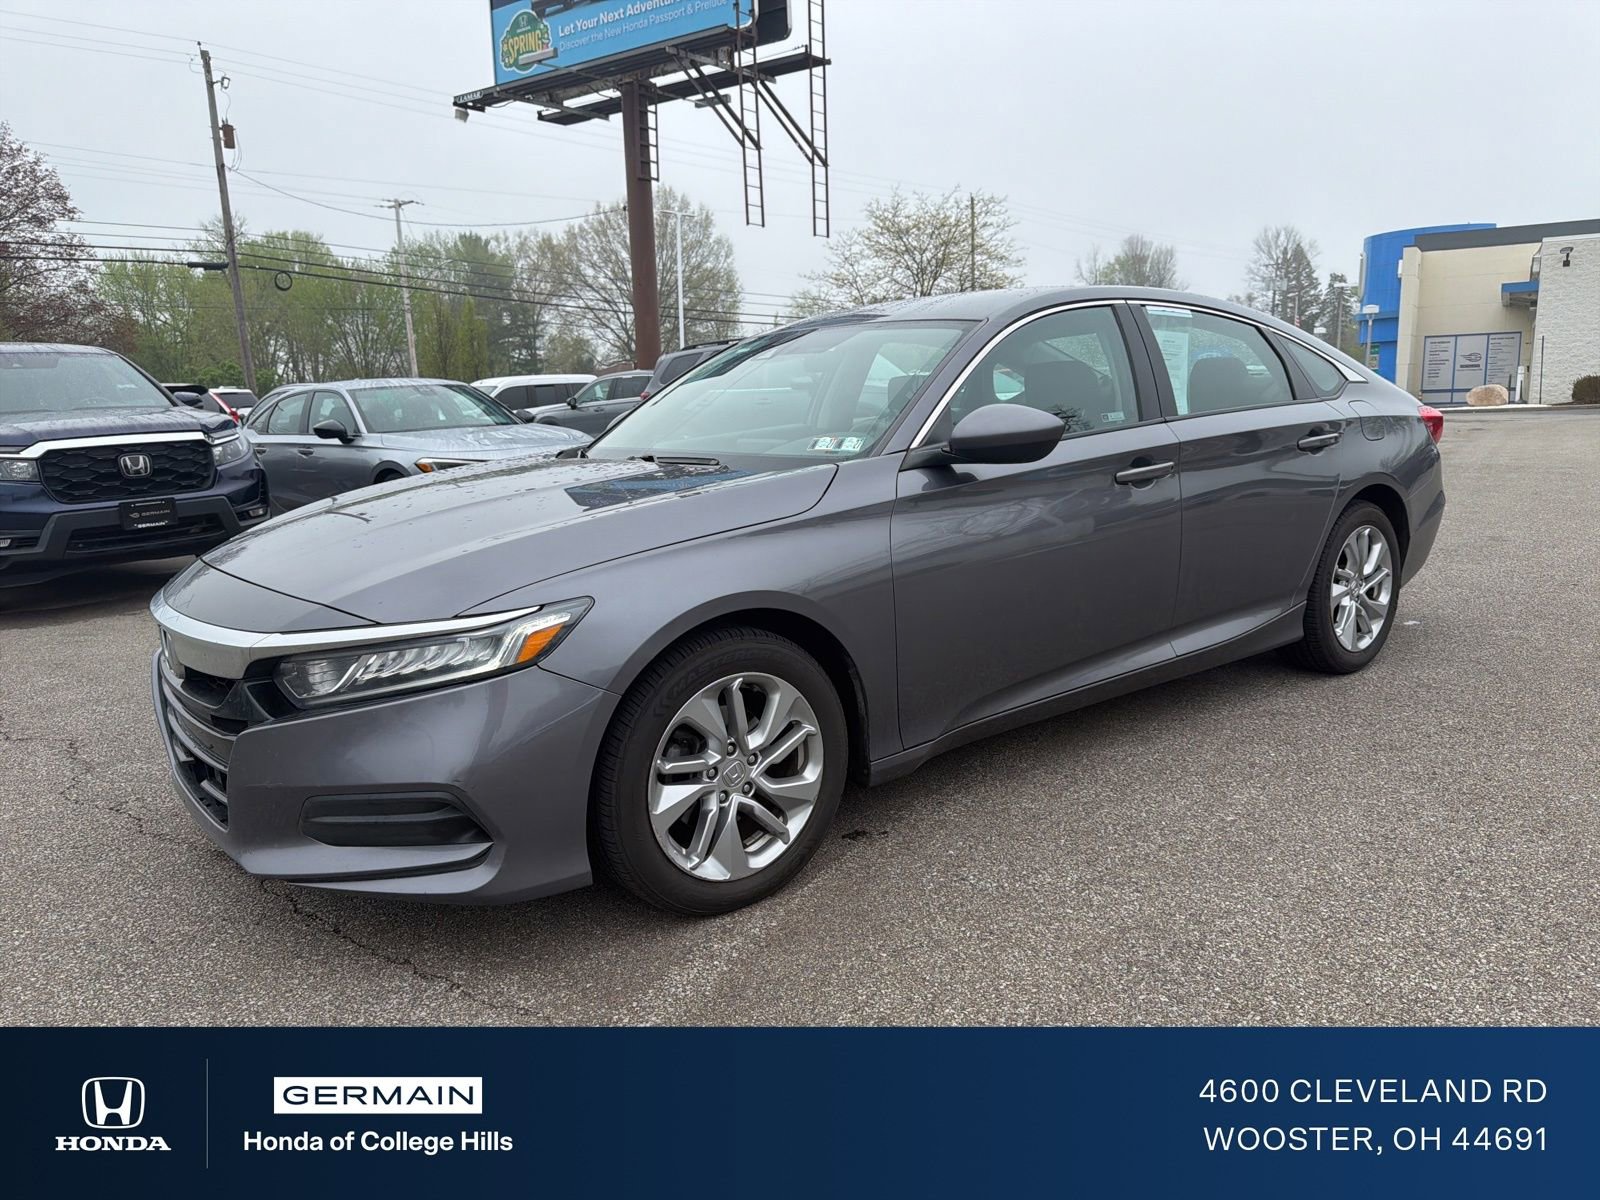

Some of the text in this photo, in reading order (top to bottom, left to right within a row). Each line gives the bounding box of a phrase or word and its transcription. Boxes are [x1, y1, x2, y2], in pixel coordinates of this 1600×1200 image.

[559, 0, 680, 37] Let Your Next Adventur
[559, 37, 590, 51] Discover
[591, 32, 604, 43] the
[605, 26, 622, 39] New
[623, 20, 649, 33] Honda
[649, 8, 686, 26] Passport
[687, 4, 694, 15] &
[508, 30, 542, 65] SPRING
